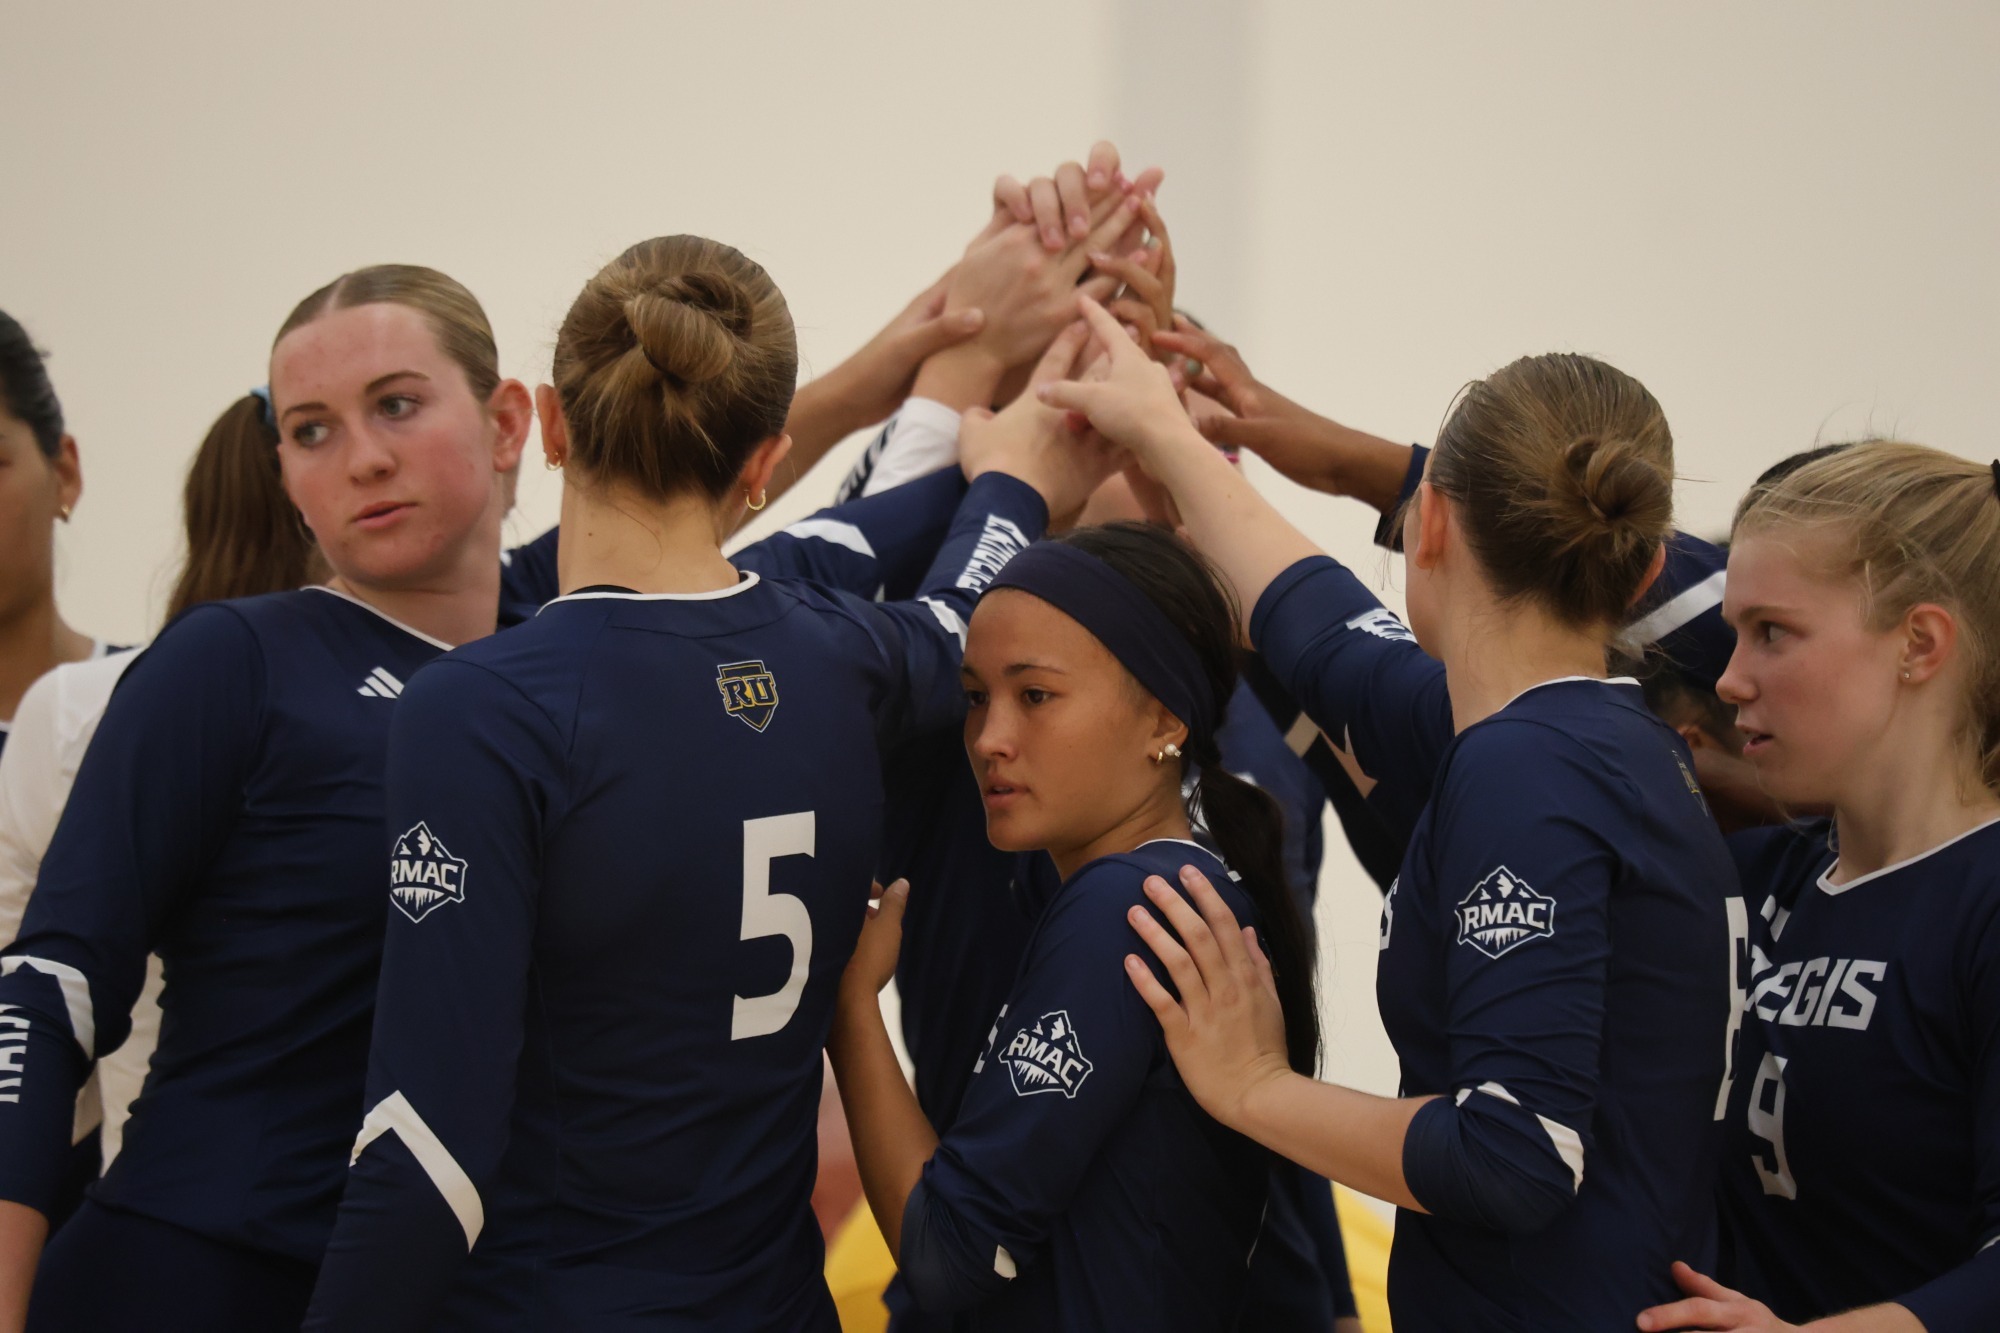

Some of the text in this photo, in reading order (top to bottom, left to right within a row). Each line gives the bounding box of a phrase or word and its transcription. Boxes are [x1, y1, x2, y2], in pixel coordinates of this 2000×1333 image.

[719, 673, 777, 711] RU
[391, 859, 459, 893] RMAC
[731, 810, 816, 1041] 5
[1463, 902, 1547, 935] RMAC
[1007, 1033, 1084, 1088] RMAC
[1747, 1051, 1797, 1200] 9
